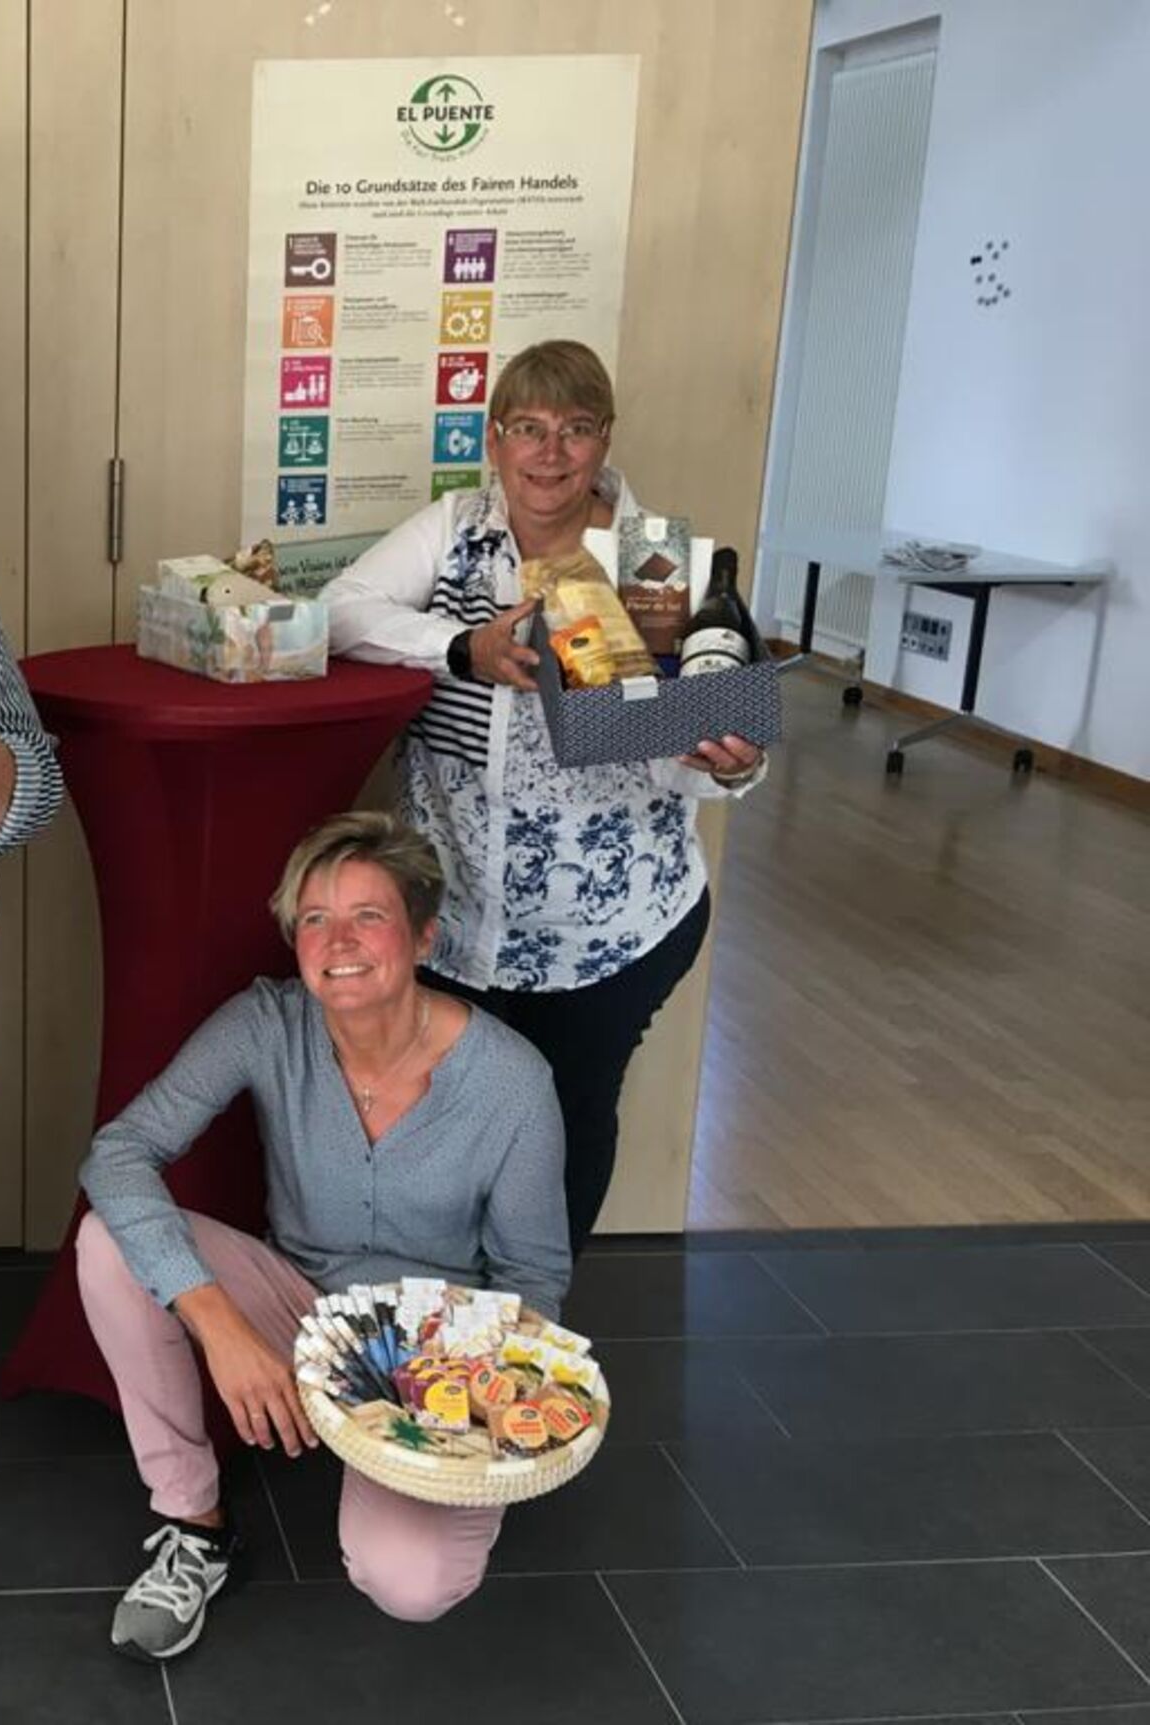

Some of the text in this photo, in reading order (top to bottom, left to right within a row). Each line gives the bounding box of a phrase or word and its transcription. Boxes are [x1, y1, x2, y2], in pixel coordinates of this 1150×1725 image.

[397, 105, 495, 122] EL PUENTE
[306, 174, 578, 195] Die 10 Grundsätze des Fairen Handels
